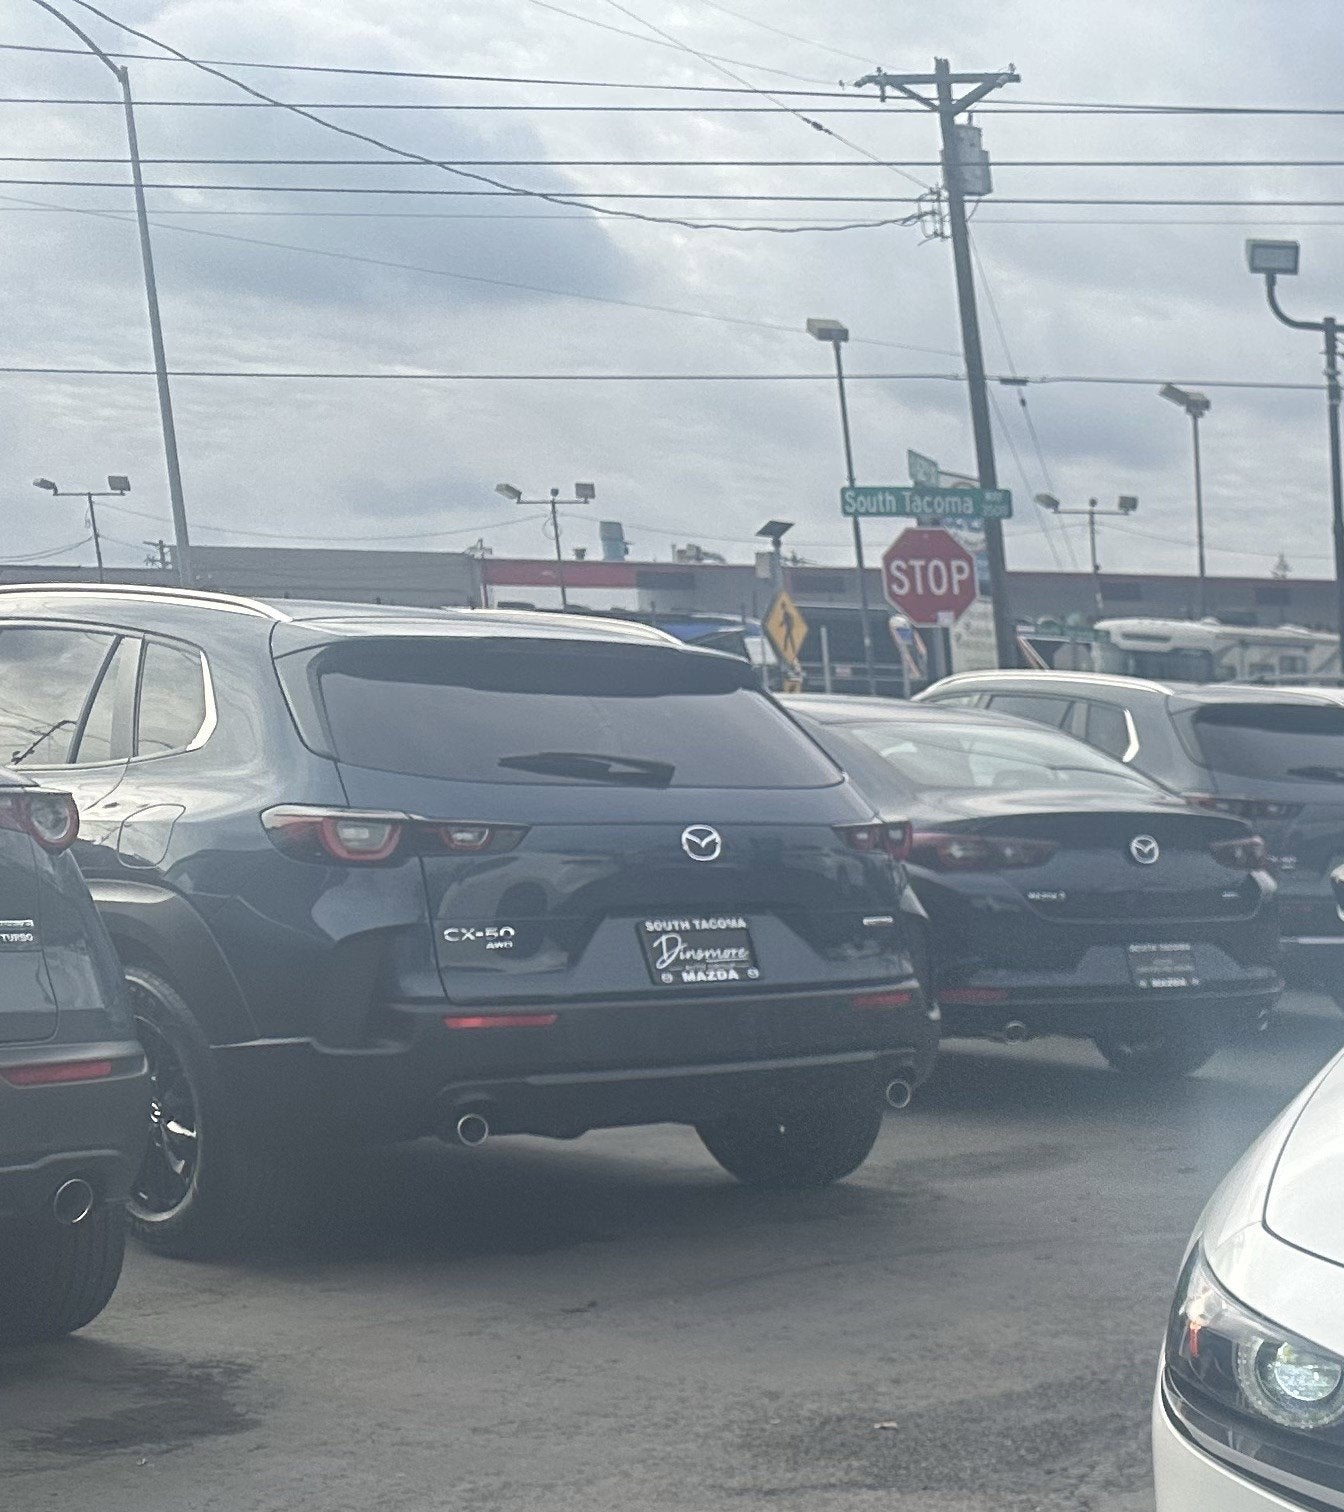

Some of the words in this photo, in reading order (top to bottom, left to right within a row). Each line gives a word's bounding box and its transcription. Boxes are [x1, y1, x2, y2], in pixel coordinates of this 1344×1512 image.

[844, 490, 897, 514] South
[903, 492, 975, 515] Tacoma
[890, 559, 970, 597] STOP
[443, 926, 515, 942] CX-50
[645, 920, 690, 932] SOUTH
[692, 917, 747, 930] TACOMA
[653, 932, 750, 970] Dinsmore
[681, 968, 739, 983] MAZDA
